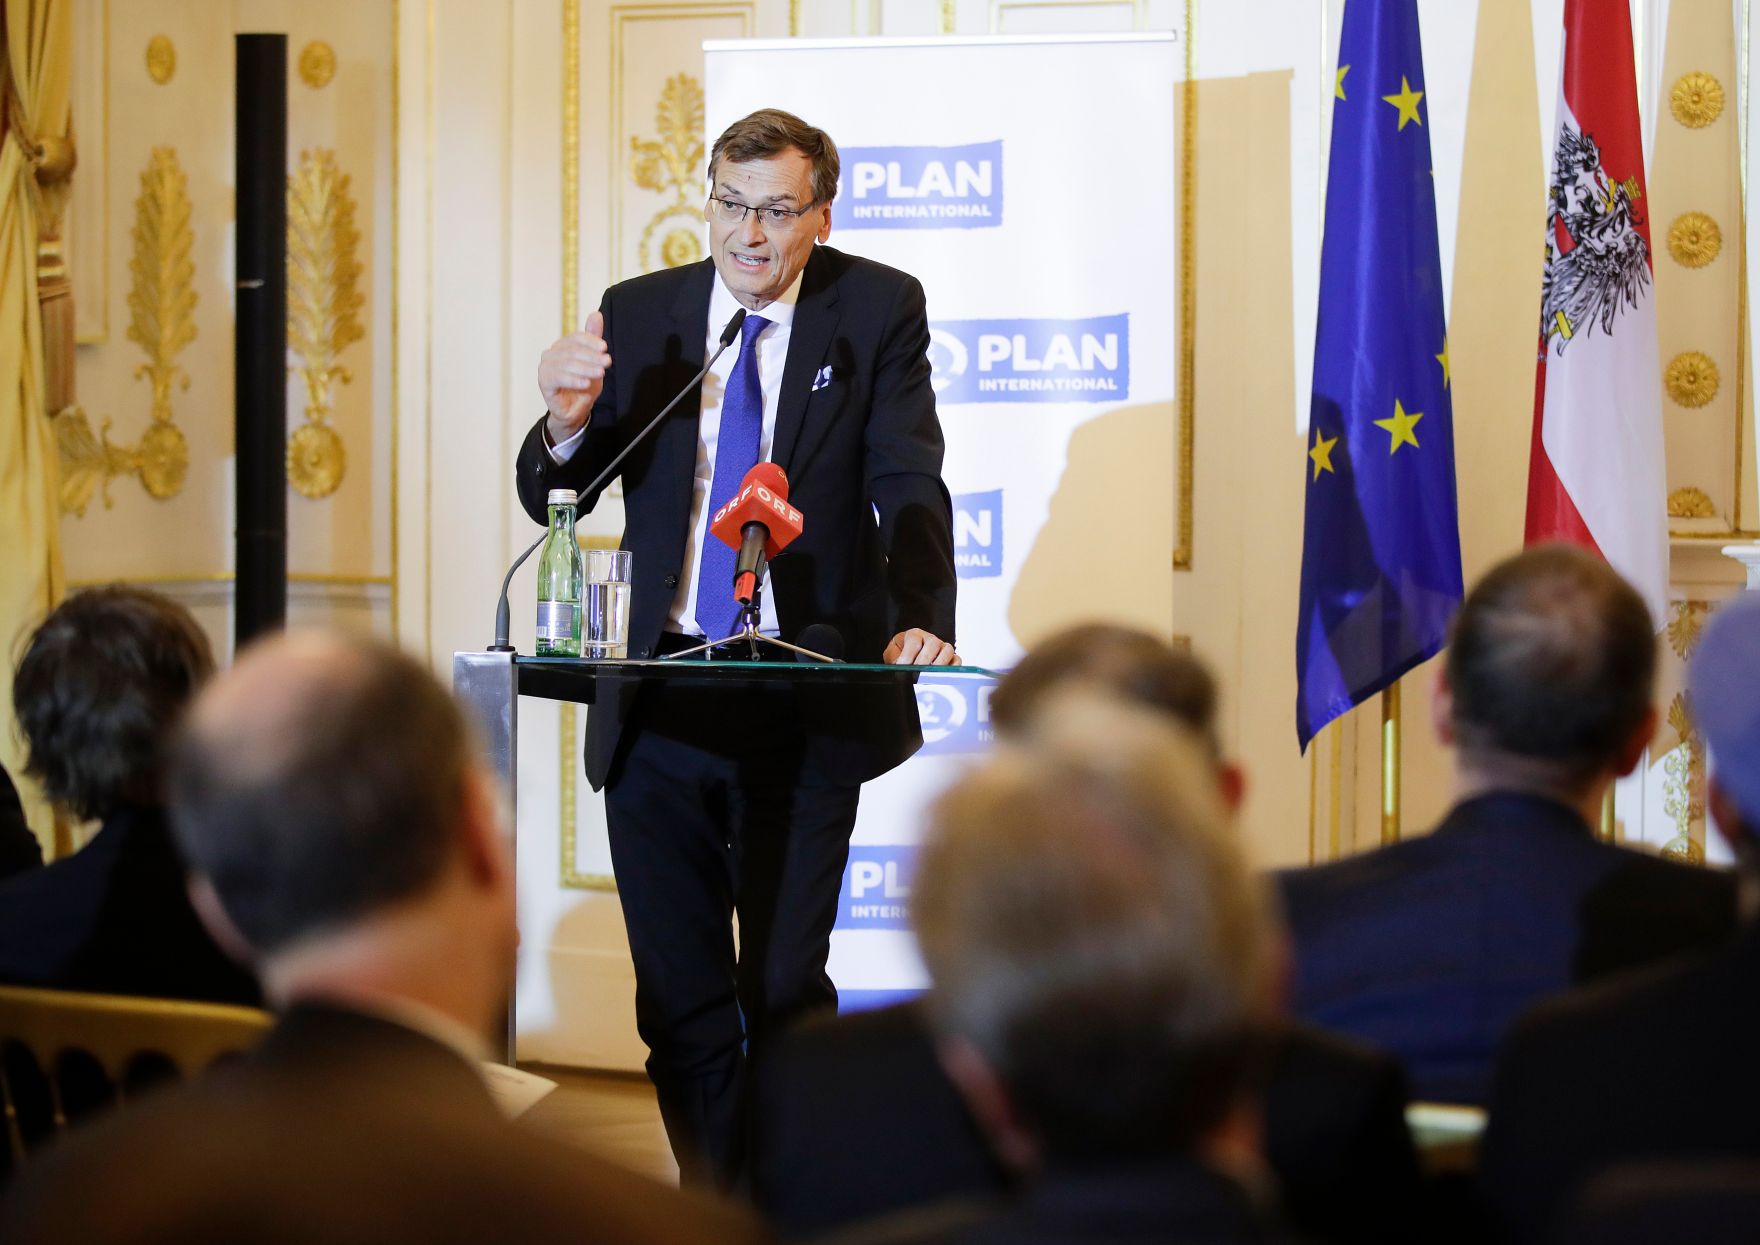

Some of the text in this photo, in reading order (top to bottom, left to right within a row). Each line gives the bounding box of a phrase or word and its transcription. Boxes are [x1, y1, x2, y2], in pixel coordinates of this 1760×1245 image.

[852, 160, 992, 199] PLAN
[853, 205, 992, 219] INTERNATIONAL
[978, 333, 1118, 372] PLAN
[978, 378, 1118, 392] INTERNATIONAL
[714, 484, 753, 523] ORF
[757, 487, 801, 523] ORF
[850, 860, 913, 899] PL
